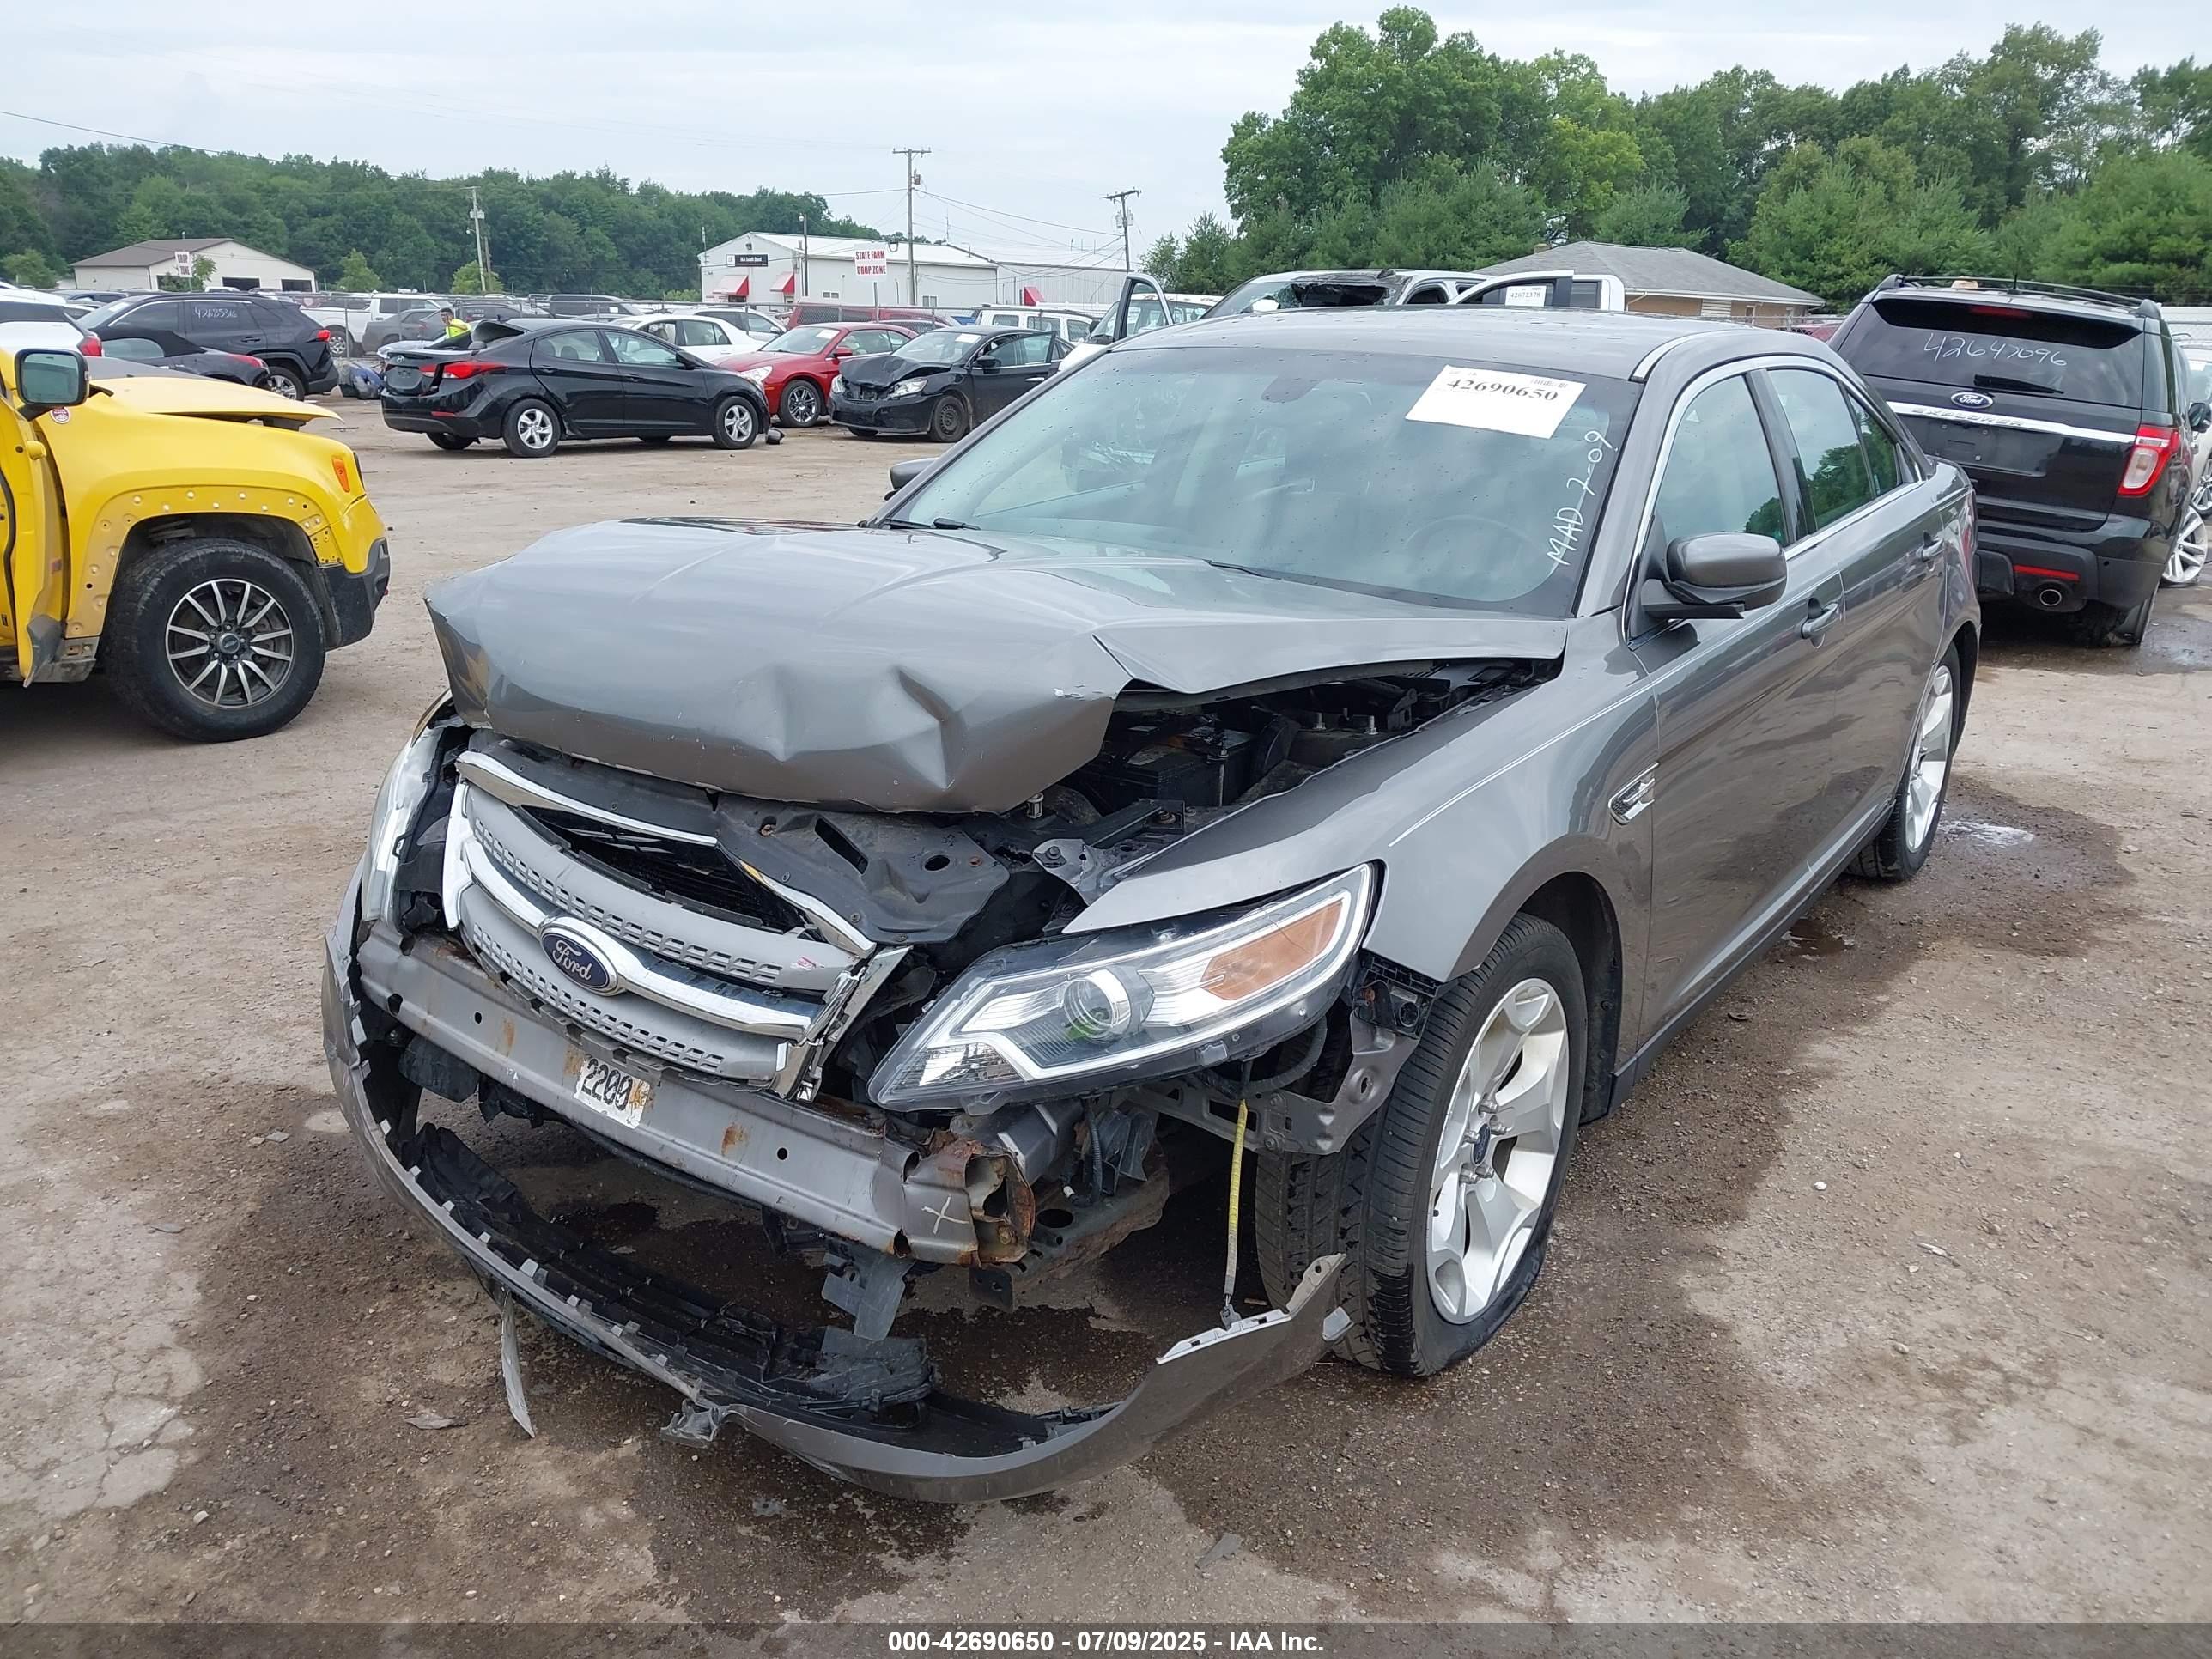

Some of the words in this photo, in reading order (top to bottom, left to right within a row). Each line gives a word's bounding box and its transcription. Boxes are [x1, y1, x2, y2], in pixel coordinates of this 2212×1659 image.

[855, 251, 870, 259] STATE
[871, 250, 885, 259] FARM
[857, 265, 872, 275] DROP
[872, 265, 886, 274] ZONE
[1924, 332, 2067, 366] 42647096
[1447, 379, 1559, 401] 42690650
[1547, 507, 1583, 565] MAD
[552, 939, 592, 981] Ford
